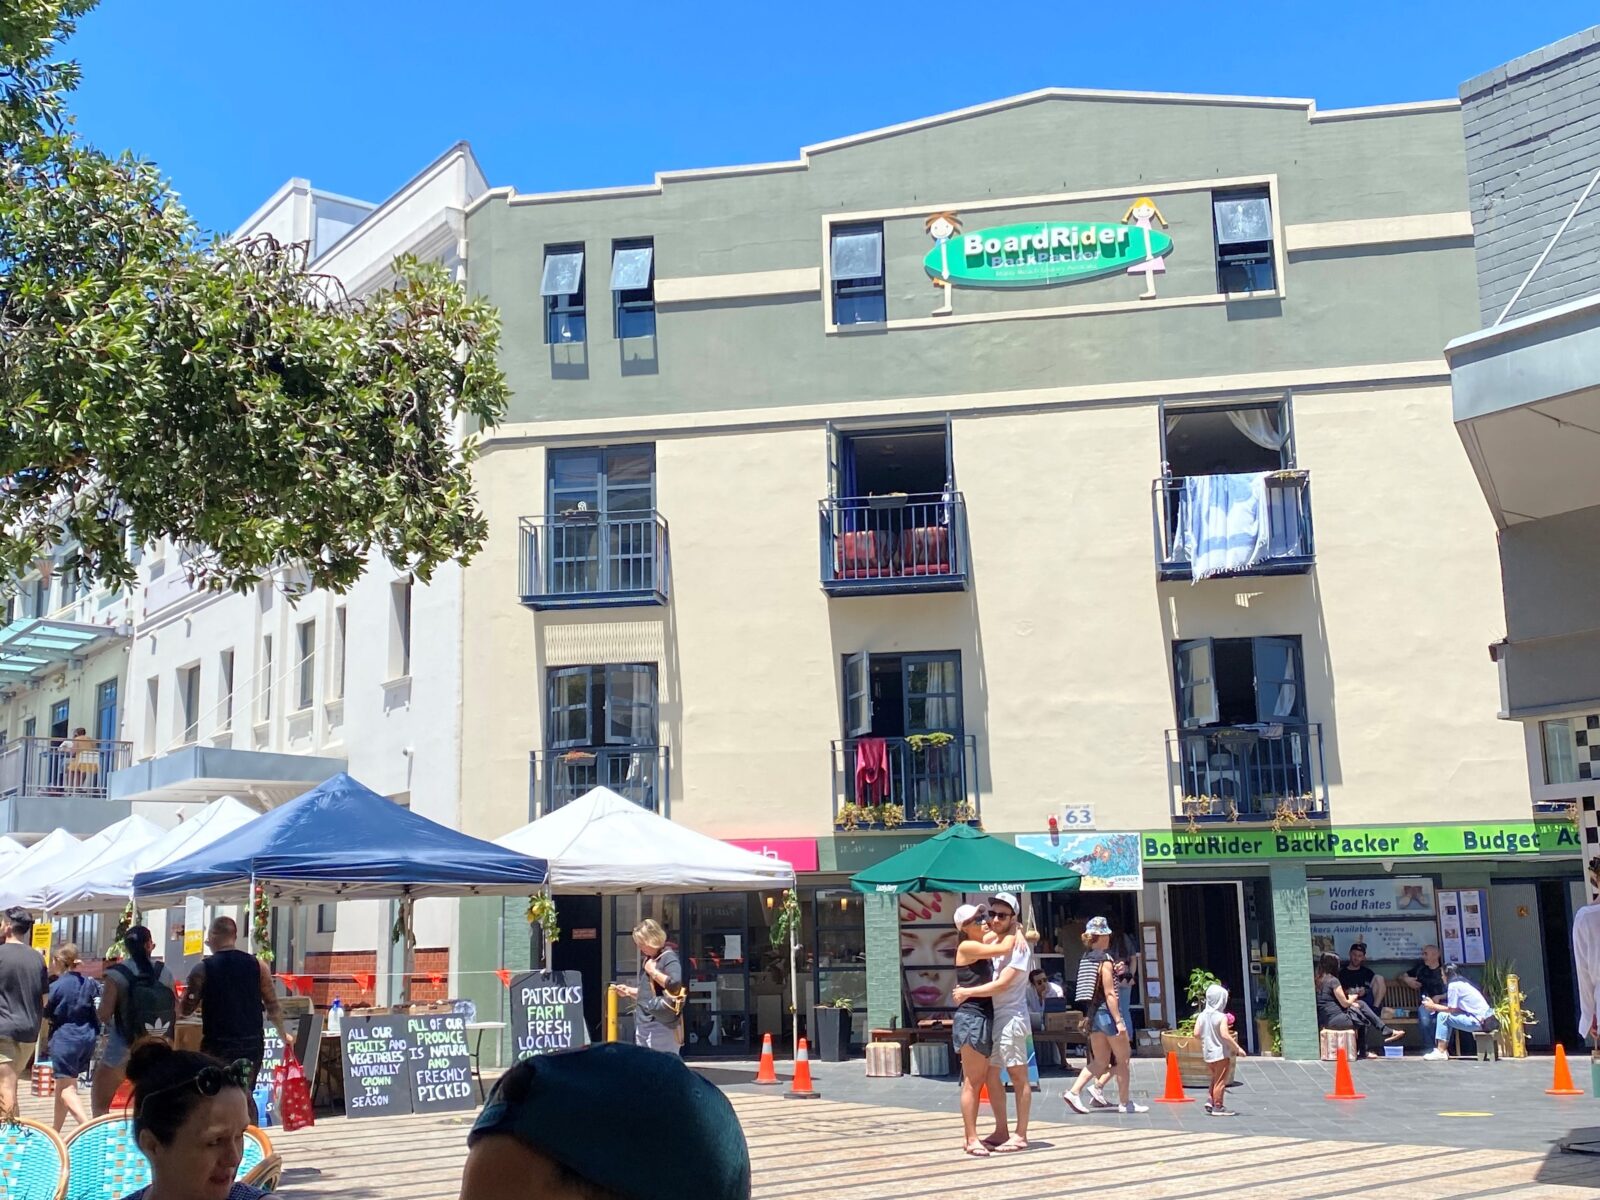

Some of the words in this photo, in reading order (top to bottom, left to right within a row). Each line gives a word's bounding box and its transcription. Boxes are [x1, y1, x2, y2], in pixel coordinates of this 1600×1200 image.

[964, 226, 1129, 256] BoardRider
[1065, 810, 1092, 824] 63
[1145, 836, 1262, 857] BoardRider
[1275, 833, 1400, 853] BackPacker
[1413, 832, 1429, 852] &
[1463, 830, 1540, 855] Budget
[1329, 887, 1375, 897] Workers
[1330, 900, 1358, 911] Good
[1361, 900, 1391, 910] Rates
[1333, 924, 1373, 933] Available
[527, 1005, 565, 1021] FARM
[408, 1019, 428, 1032] ALL
[429, 1018, 442, 1030] OF
[445, 1018, 463, 1030] OUR
[527, 1020, 571, 1036] FRESH
[348, 1028, 368, 1040] ALL
[371, 1027, 392, 1038] OUR
[417, 1031, 465, 1045] PRODUCE
[347, 1040, 386, 1053] FRUITS
[389, 1040, 406, 1050] AND
[518, 1034, 571, 1050] LOCALLY
[348, 1051, 404, 1065] VEGETABLES
[409, 1047, 424, 1060] IS
[430, 1044, 469, 1058] NATURAL
[350, 1064, 400, 1077] NATURALLY
[428, 1058, 450, 1069] AND
[361, 1076, 392, 1086] GROWN
[416, 1067, 467, 1084] FRESHLY
[365, 1087, 379, 1096] IN
[417, 1082, 471, 1101] PICKED
[352, 1096, 389, 1107] SEASON
